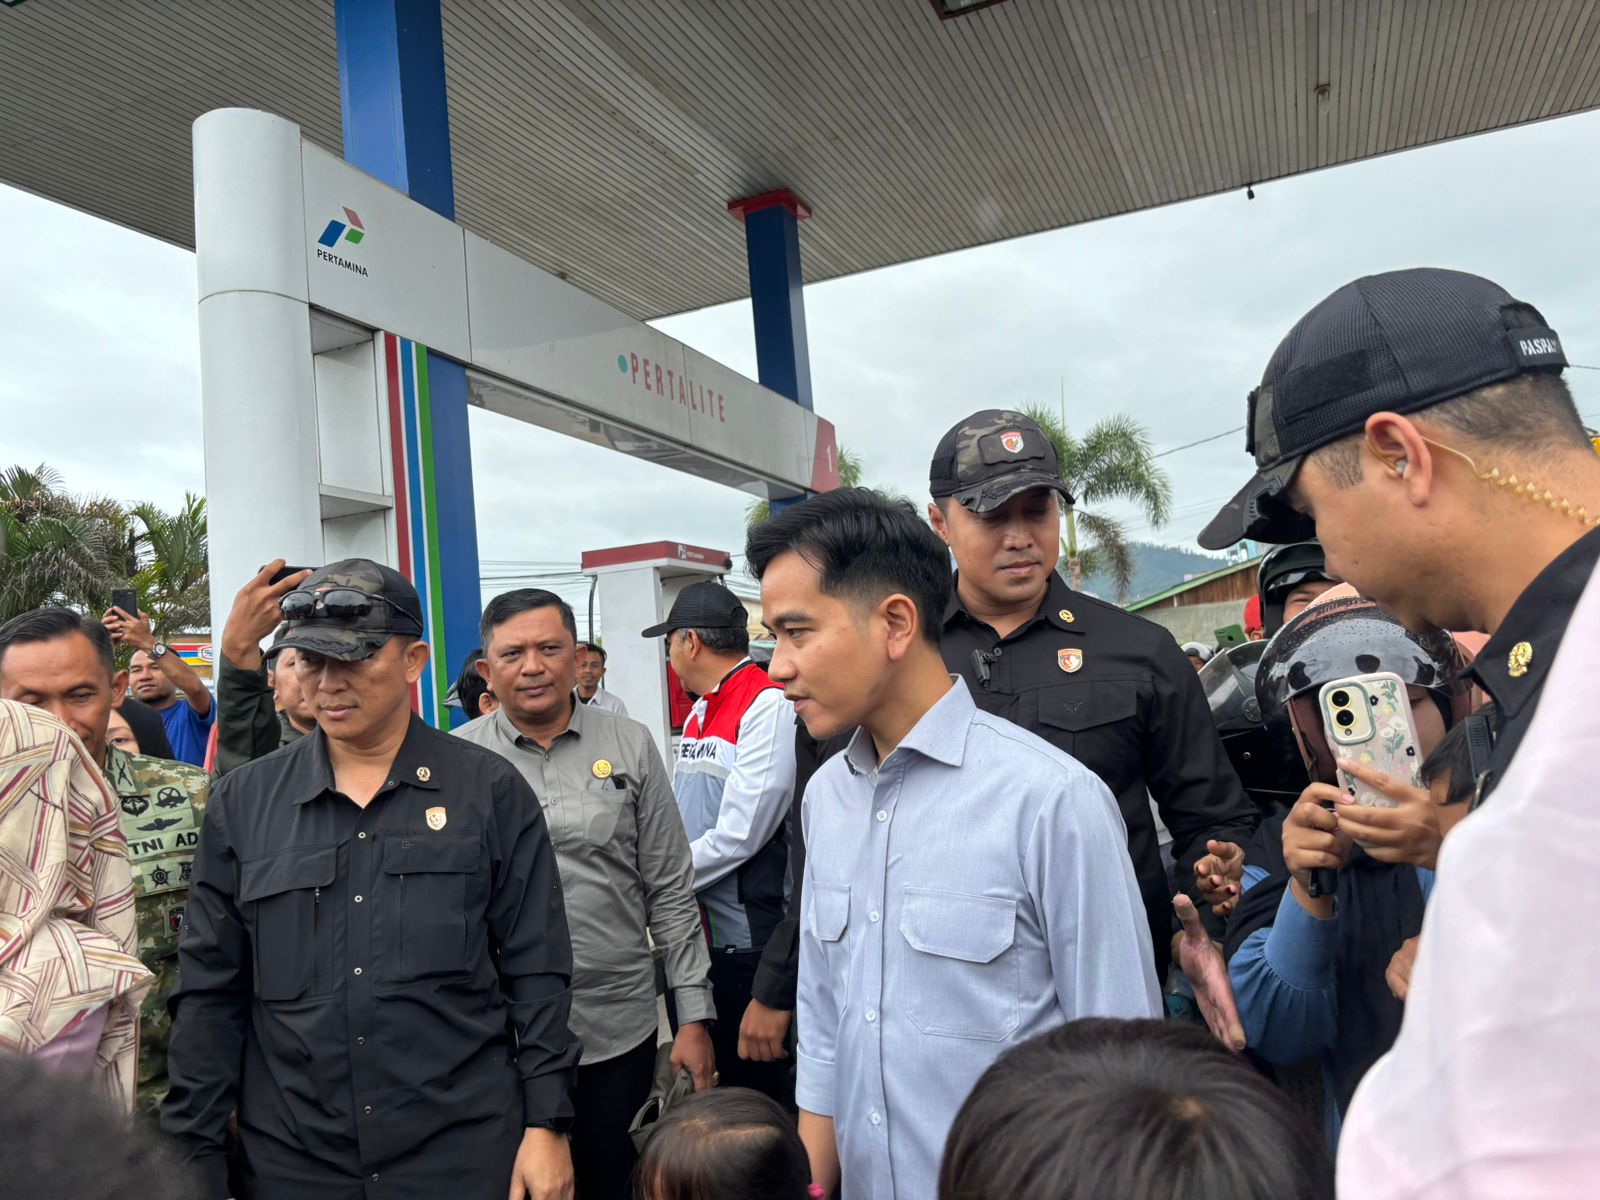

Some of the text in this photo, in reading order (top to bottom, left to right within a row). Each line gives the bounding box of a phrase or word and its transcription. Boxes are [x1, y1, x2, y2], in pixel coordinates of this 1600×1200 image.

[317, 249, 368, 277] PERTAMINA
[630, 352, 725, 423] PERTALITE
[825, 444, 833, 473] 1
[128, 832, 199, 855] TNI AD
